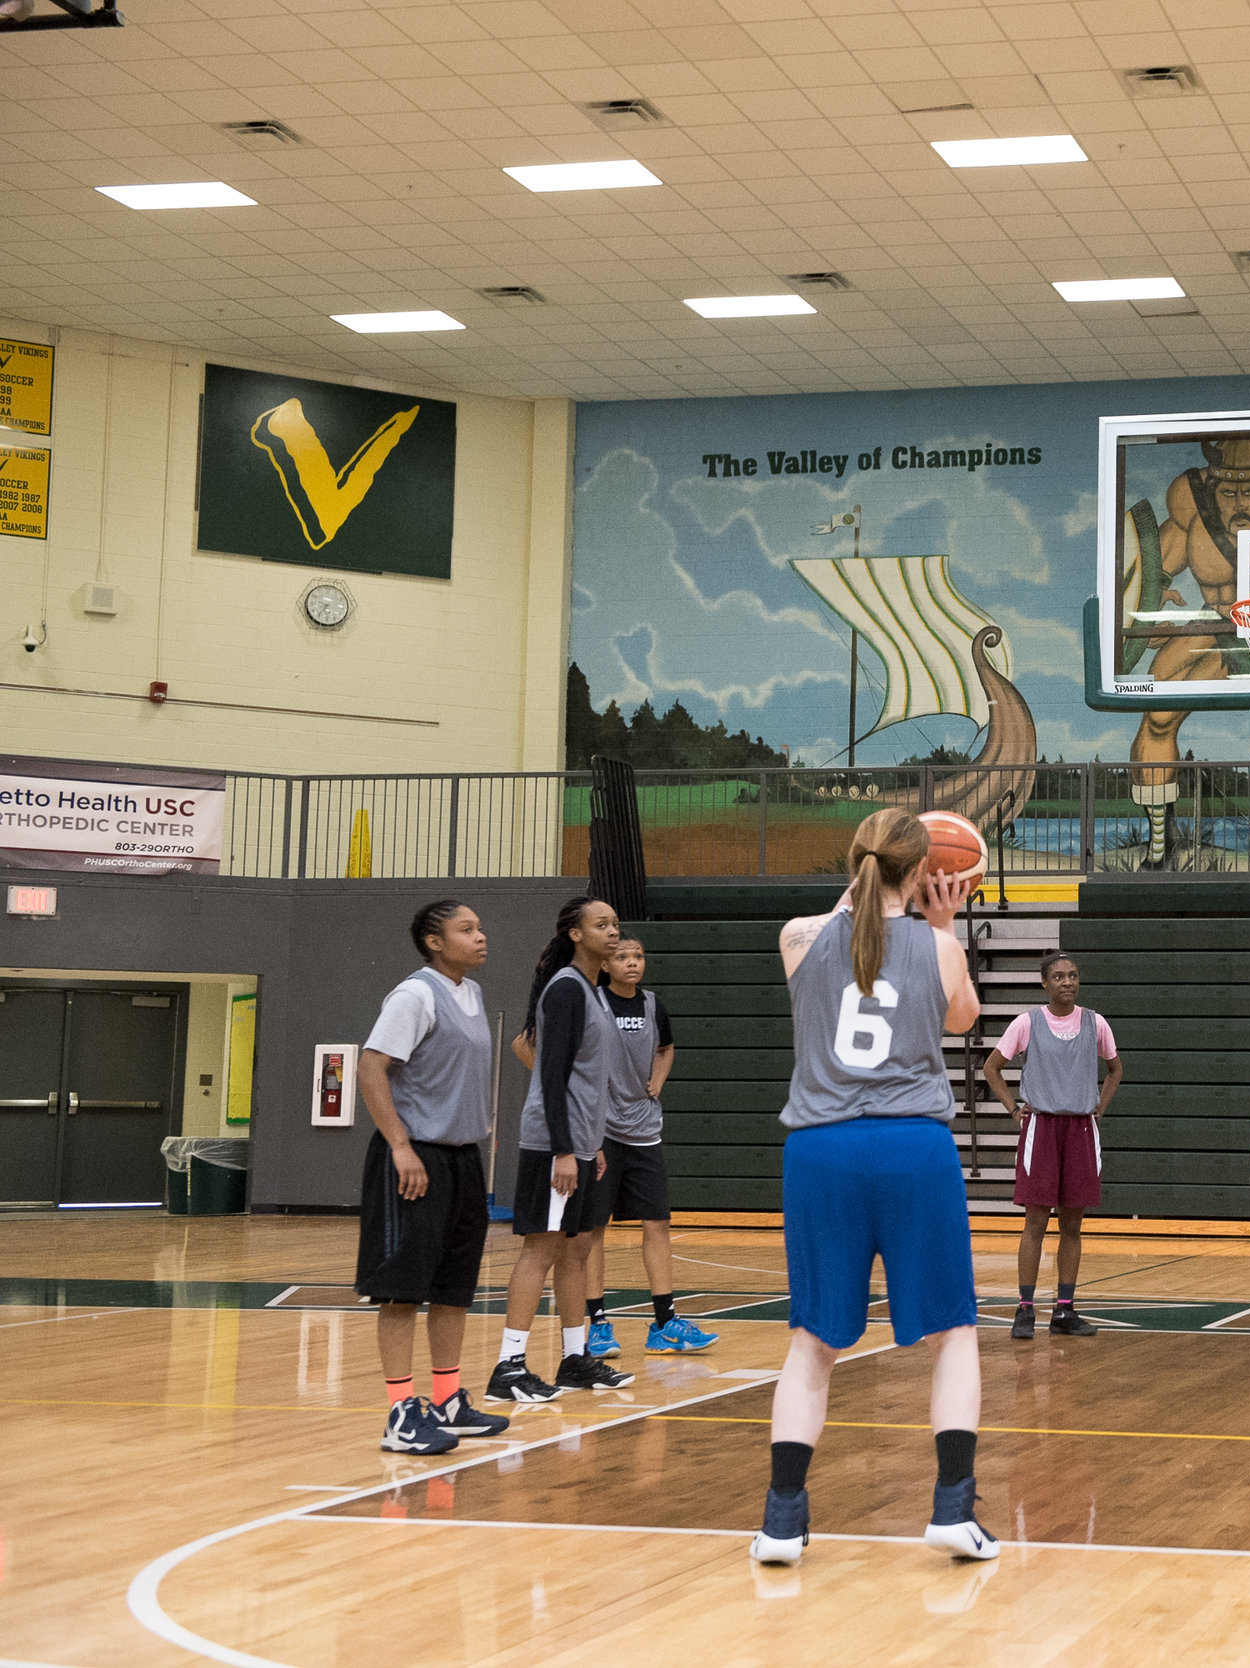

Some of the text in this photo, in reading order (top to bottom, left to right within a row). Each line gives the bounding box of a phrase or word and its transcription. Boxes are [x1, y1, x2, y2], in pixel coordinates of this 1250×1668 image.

[18, 346, 49, 358] VIKINGS
[0, 373, 34, 386] SOCCER
[5, 417, 45, 430] CHAMPIONS
[0, 447, 46, 462] LEY VIKINGS
[702, 442, 1042, 479] The Valley of Champions
[0, 490, 41, 503] 1982 1987
[0, 501, 43, 514] 2007 2008
[1, 521, 42, 535] CHAMPIONS
[1114, 683, 1154, 694] SPALDING
[58, 791, 137, 813] Health
[145, 797, 196, 817] USC
[116, 820, 194, 837] CENTER
[115, 842, 194, 854] 803-29ORTHO
[84, 857, 193, 871] PHUSCOrthoCenter.org
[16, 888, 48, 912] EXIT
[833, 980, 899, 1069] 6
